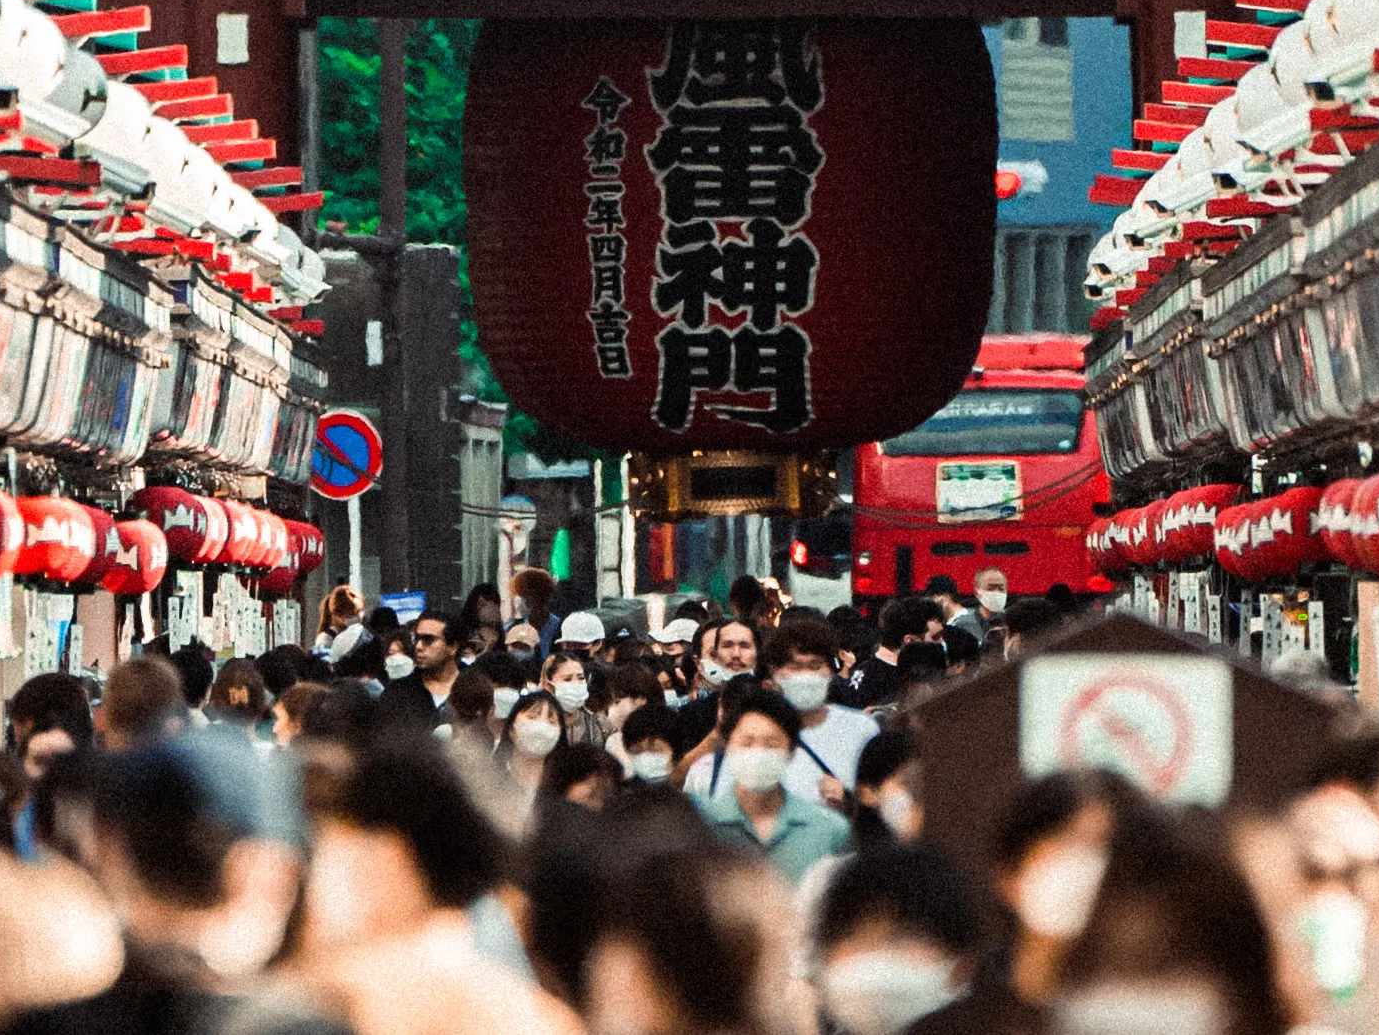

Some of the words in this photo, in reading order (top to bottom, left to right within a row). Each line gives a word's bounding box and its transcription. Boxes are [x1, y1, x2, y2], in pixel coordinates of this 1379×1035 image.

[581, 74, 633, 380] 令和二年四月吉日
[645, 18, 826, 434] 風雷神門
